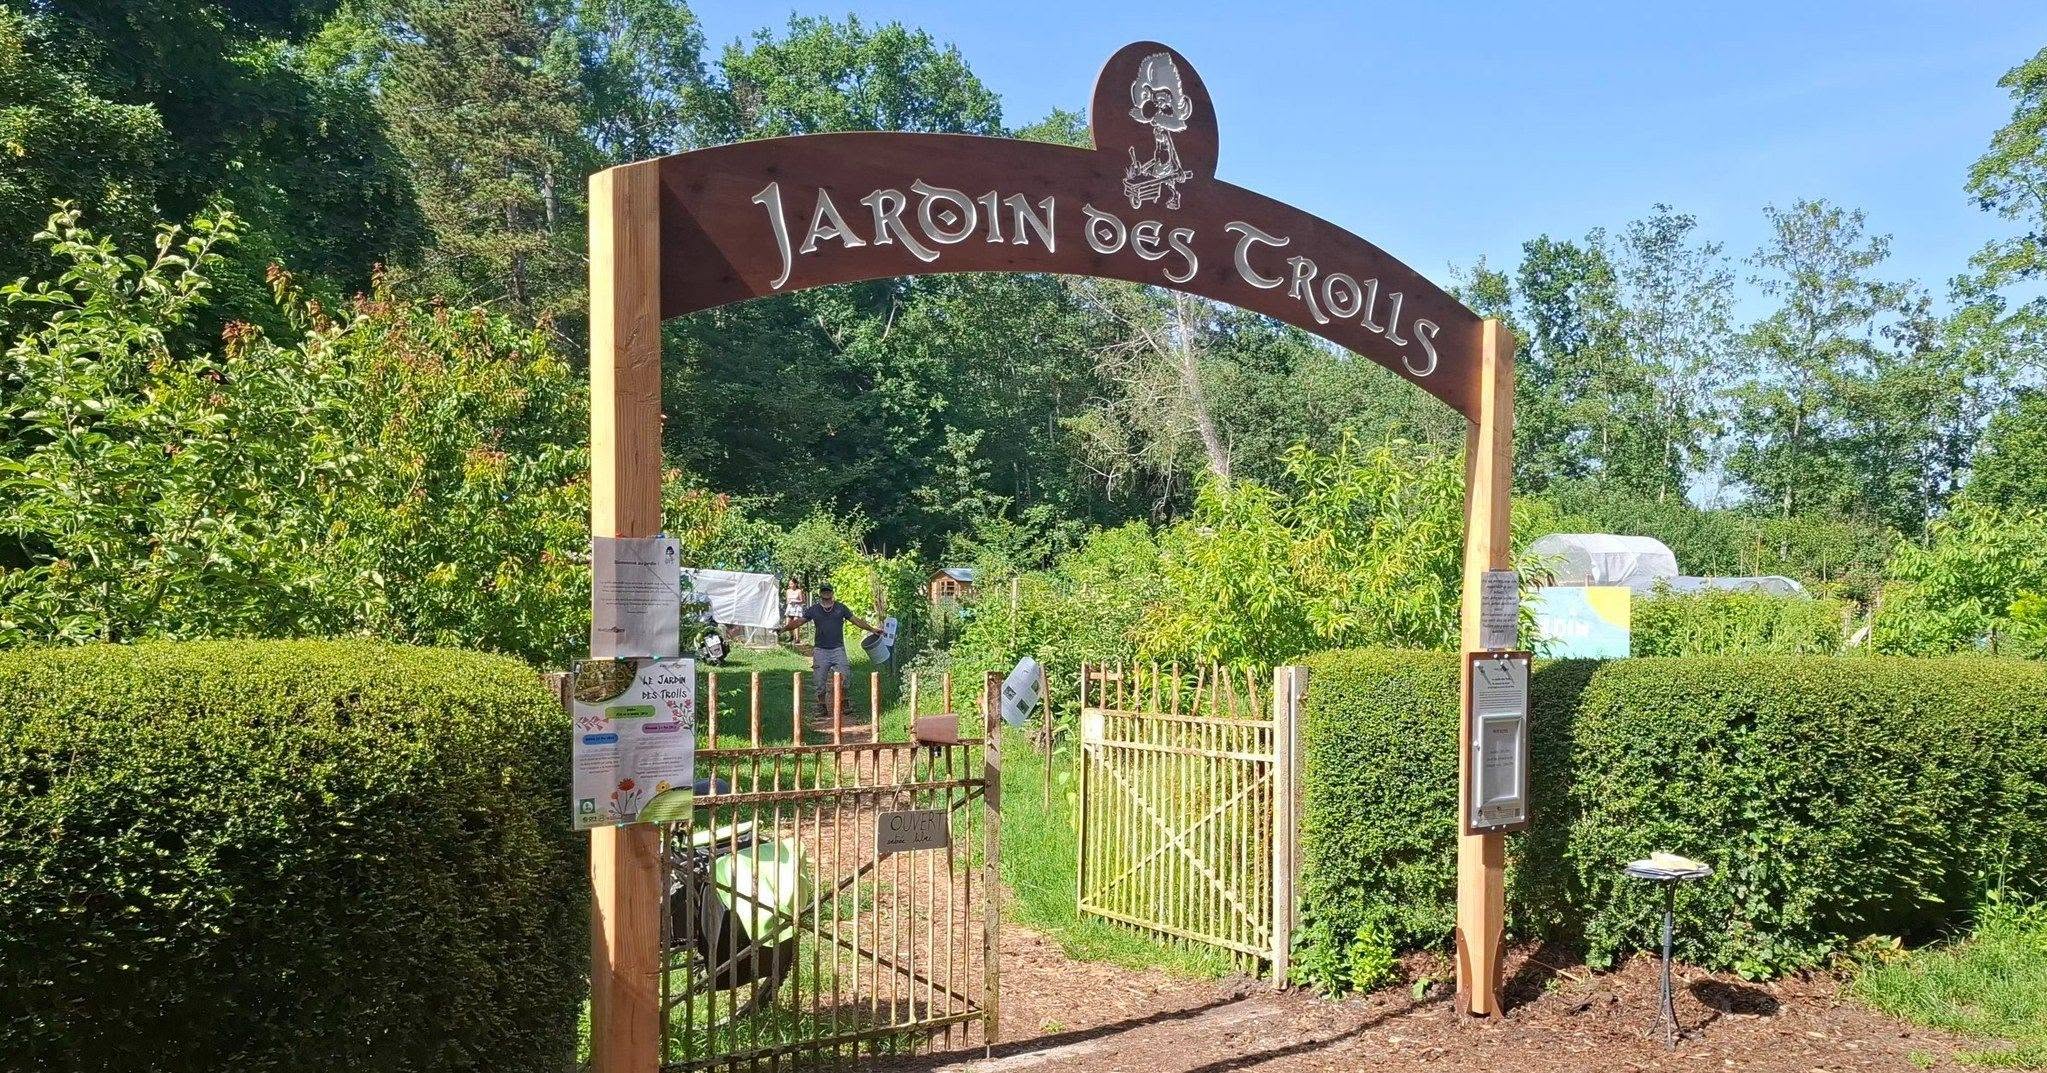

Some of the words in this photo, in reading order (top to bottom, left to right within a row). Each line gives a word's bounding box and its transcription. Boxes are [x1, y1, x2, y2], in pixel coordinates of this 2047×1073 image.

[751, 179, 1057, 290] JARDIN
[1083, 203, 1199, 283] DES
[1224, 220, 1440, 378] TROLLS
[643, 676, 653, 685] LE
[657, 674, 687, 685] JARDIN
[642, 691, 658, 700] DES
[890, 811, 944, 831] OUVERT
